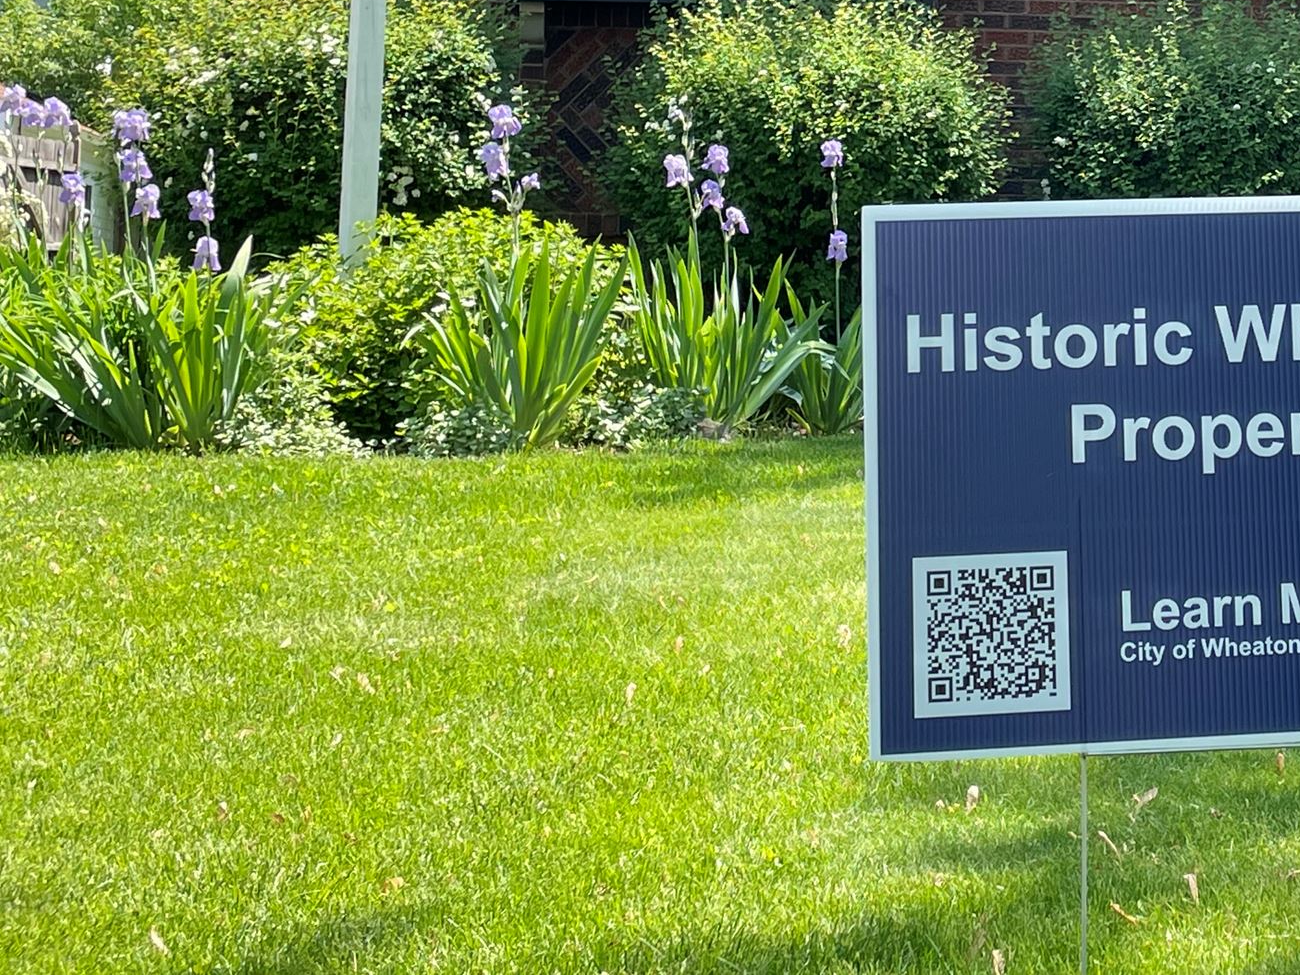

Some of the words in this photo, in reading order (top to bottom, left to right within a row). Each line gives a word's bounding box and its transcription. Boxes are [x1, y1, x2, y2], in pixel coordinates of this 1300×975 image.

[905, 307, 1194, 374] Historic
[1121, 589, 1263, 632] Learn
[1120, 640, 1166, 666] City
[1172, 638, 1196, 660] of
